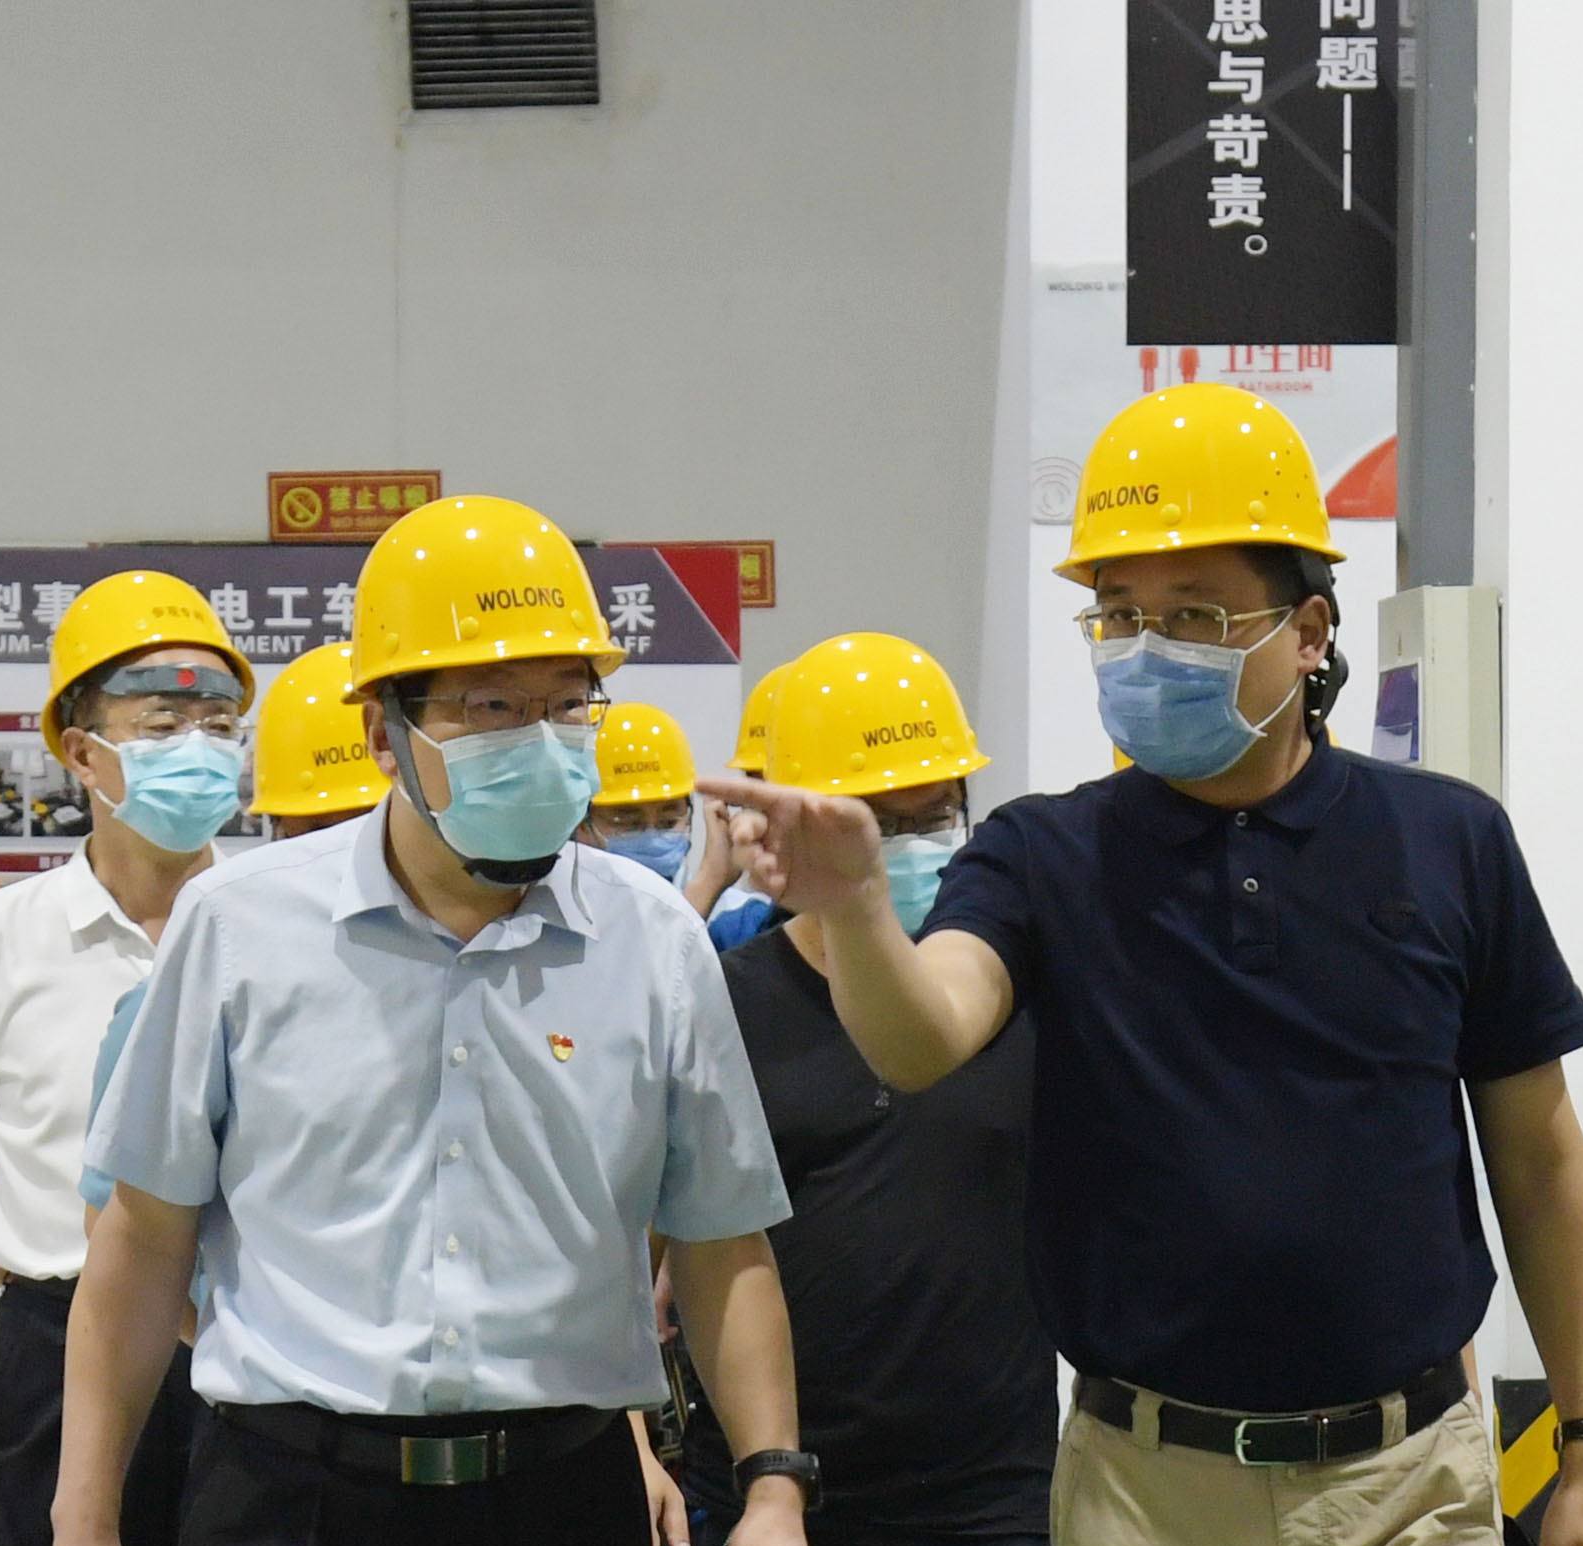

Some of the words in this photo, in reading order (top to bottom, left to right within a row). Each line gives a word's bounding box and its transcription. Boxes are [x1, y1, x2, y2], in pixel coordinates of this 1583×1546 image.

[1086, 484, 1159, 516] WOLONG
[475, 586, 565, 613] WOLONG
[233, 634, 305, 654] MENT
[862, 719, 938, 749] WOLONG
[612, 761, 660, 776] WOLONG
